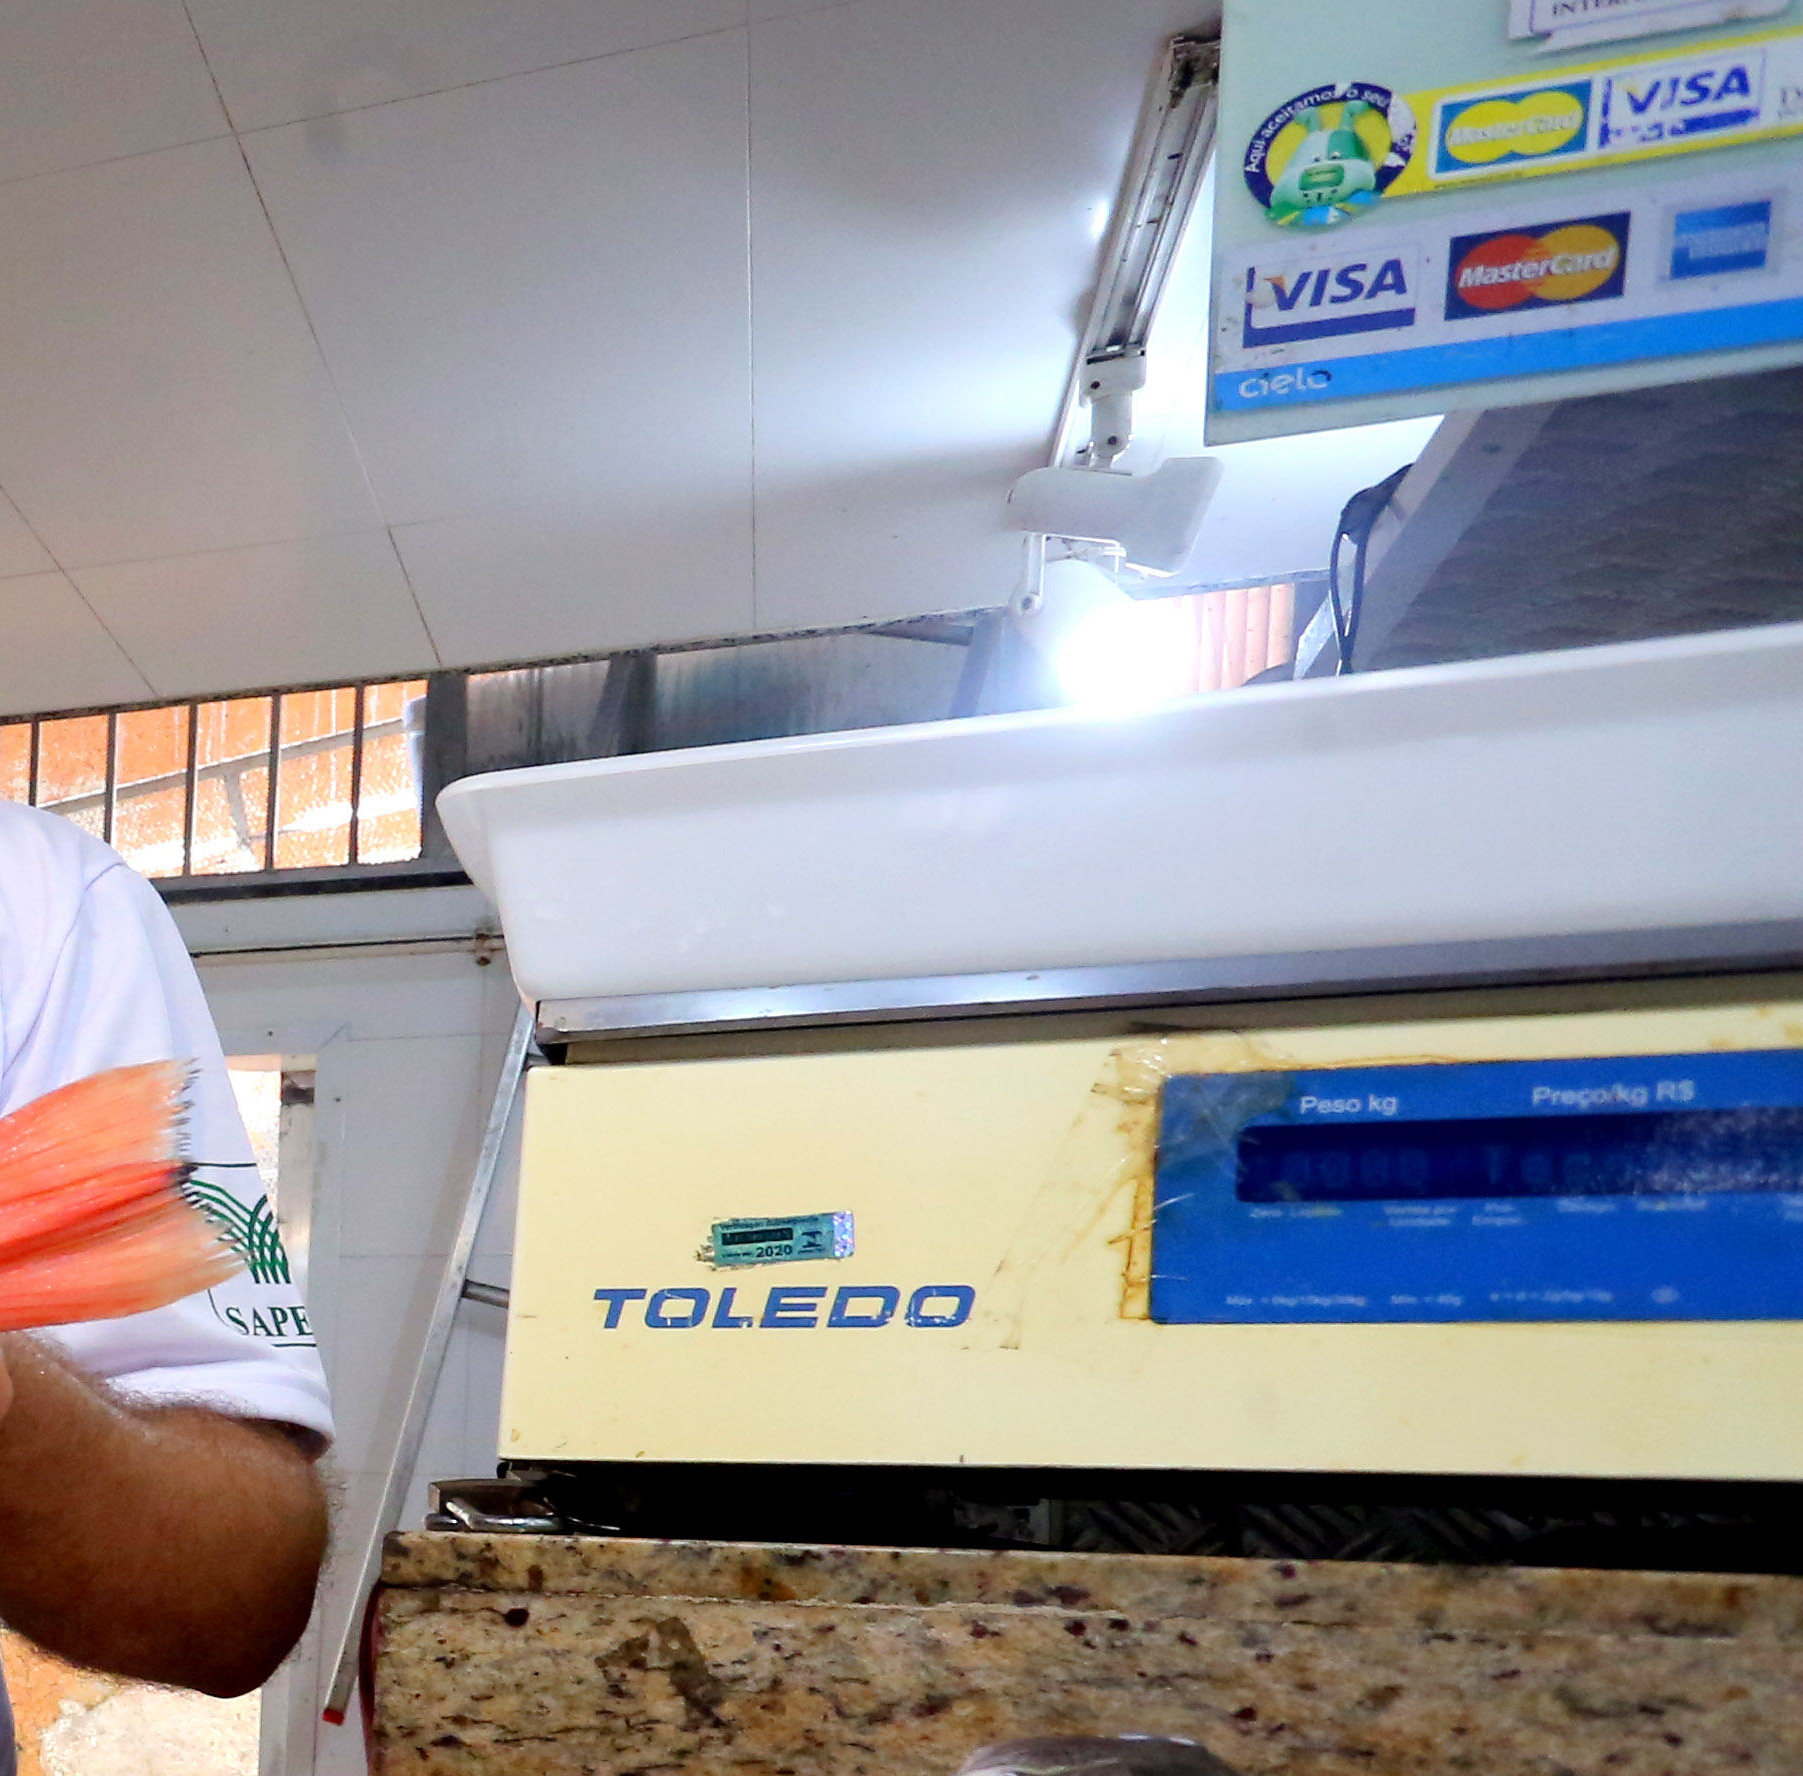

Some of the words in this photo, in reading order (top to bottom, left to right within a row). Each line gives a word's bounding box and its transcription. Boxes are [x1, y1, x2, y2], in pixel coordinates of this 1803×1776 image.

[1627, 66, 1751, 115] VISA
[1245, 139, 1266, 173] Aqui
[1264, 258, 1408, 312] VISA
[1457, 246, 1616, 290] MasterCard
[1238, 368, 1333, 399] cielo
[1300, 1094, 1362, 1115] Peso
[1368, 1094, 1399, 1117] kg
[756, 1244, 793, 1259] 2020
[593, 1285, 976, 1330] TOLEDO
